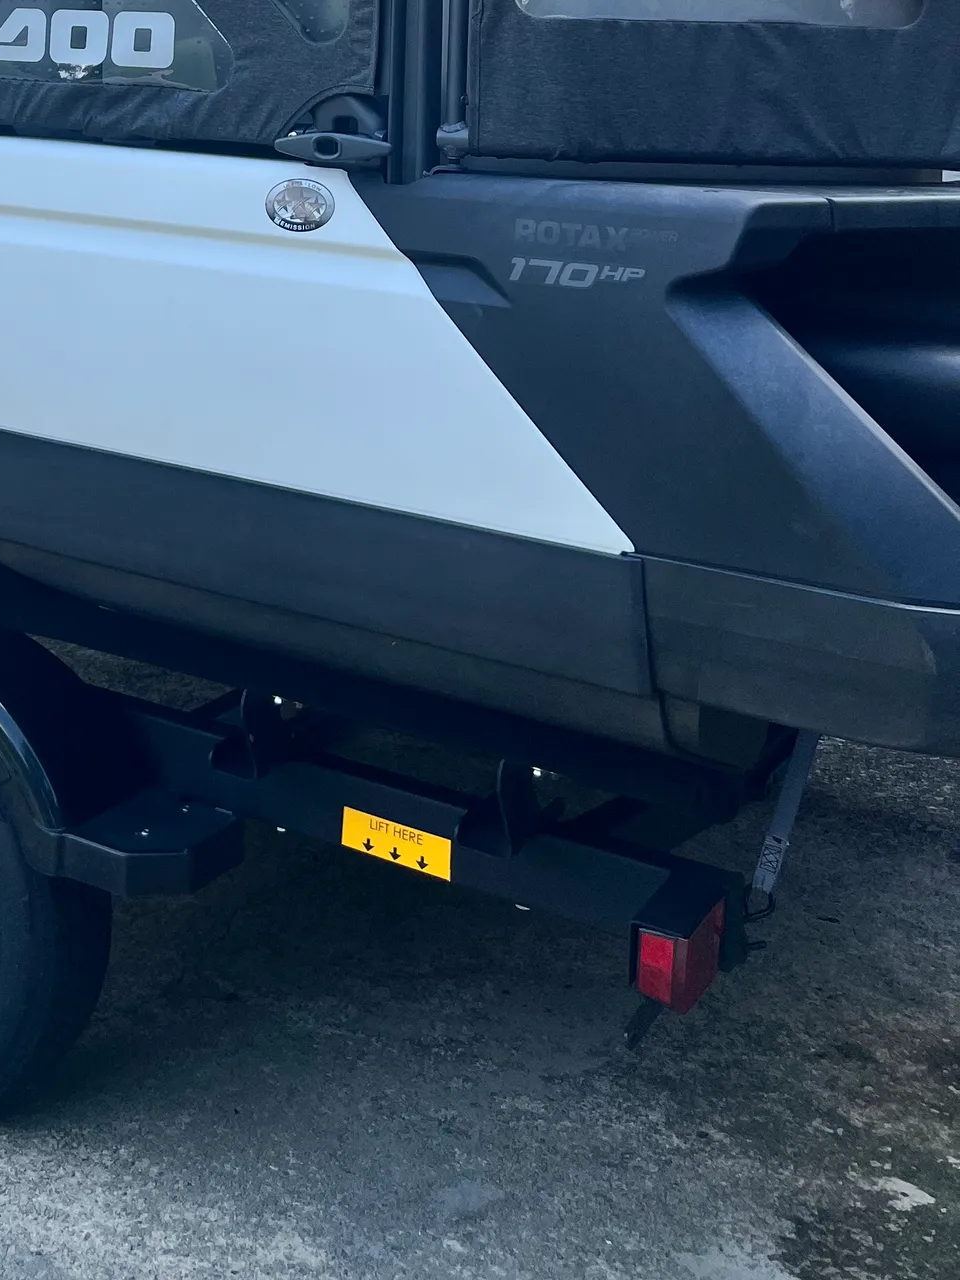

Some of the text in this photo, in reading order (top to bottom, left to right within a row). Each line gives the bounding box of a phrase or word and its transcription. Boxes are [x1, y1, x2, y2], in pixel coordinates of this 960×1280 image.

[514, 218, 629, 252] ROTAX
[369, 818, 424, 846] LIFT HERE
